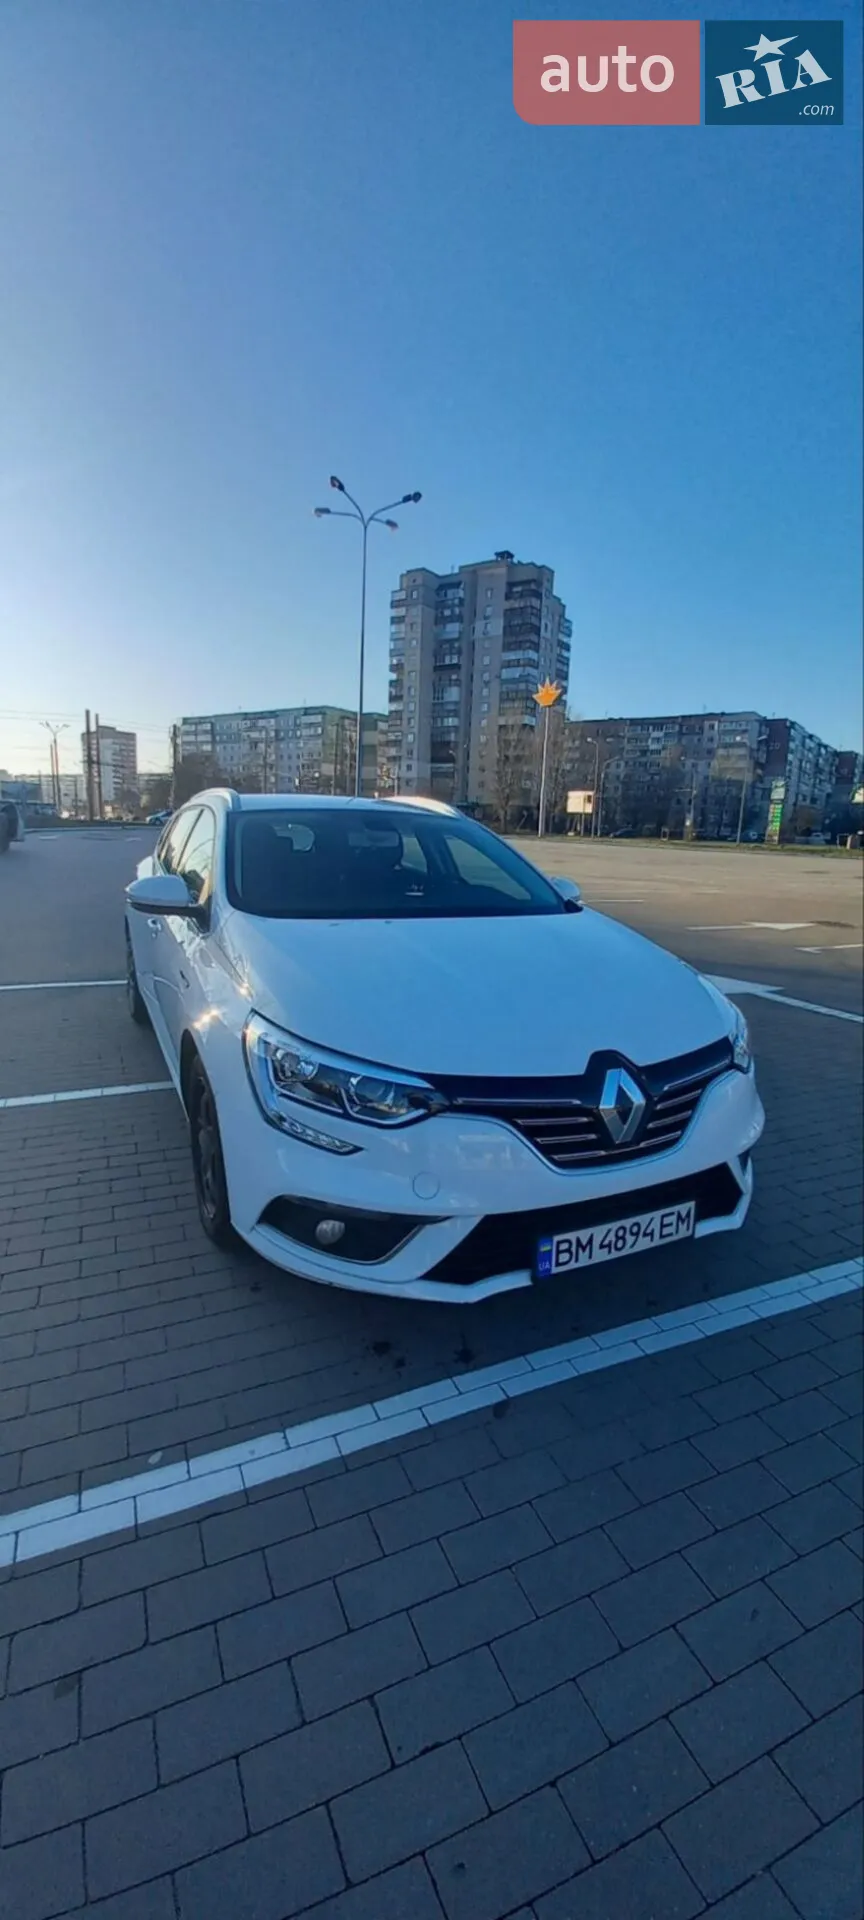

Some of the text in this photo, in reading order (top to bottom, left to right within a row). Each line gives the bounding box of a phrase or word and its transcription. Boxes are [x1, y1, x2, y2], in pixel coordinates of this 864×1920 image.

[555, 1207, 692, 1267] BM 4894 EM
[538, 1262, 551, 1271] UA
